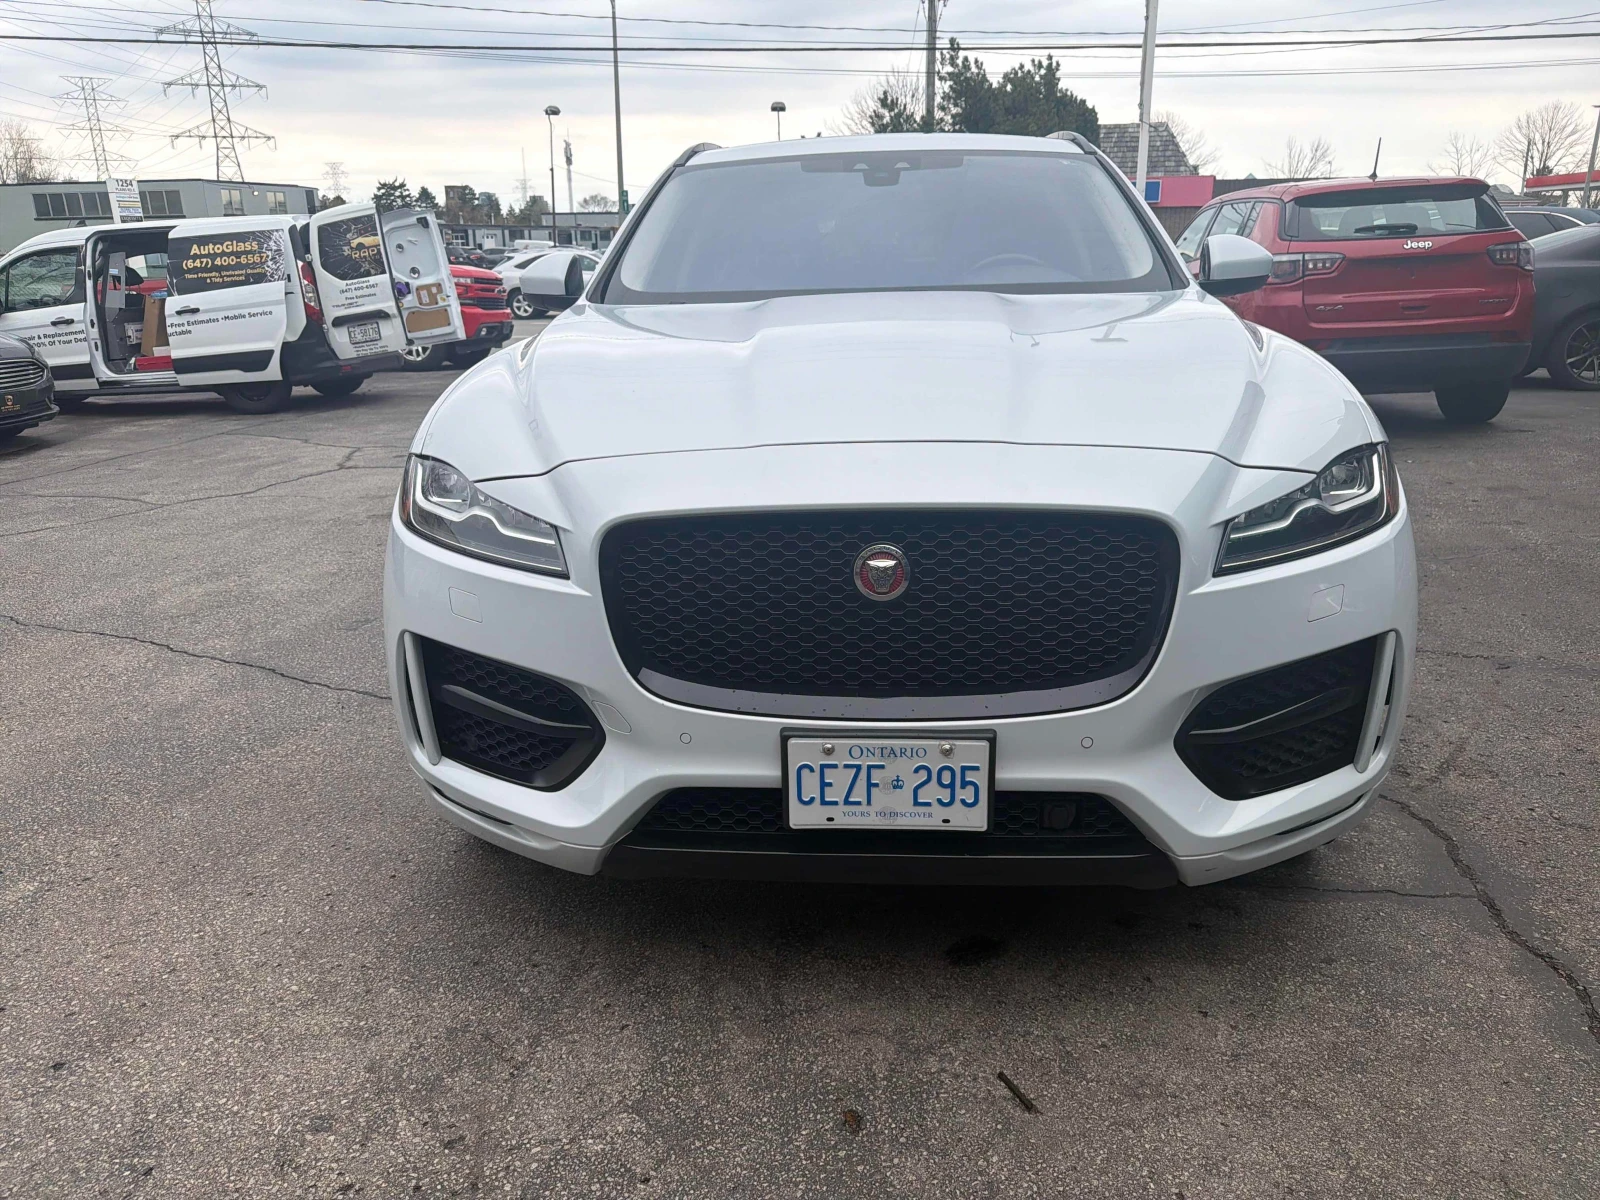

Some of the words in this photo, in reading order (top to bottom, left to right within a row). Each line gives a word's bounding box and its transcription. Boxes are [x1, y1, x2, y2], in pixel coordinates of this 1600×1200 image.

[116, 179, 133, 188] 1254
[190, 240, 258, 256] AutoGlass
[1403, 240, 1432, 250] Jeep
[352, 246, 380, 260] RAP
[182, 258, 212, 270] (647)
[214, 253, 267, 266] 400-6567
[187, 317, 219, 327] Estimates
[248, 310, 273, 318] Service
[43, 329, 85, 339] Replacement
[849, 745, 927, 760] ONTARIO
[796, 762, 885, 806] CEZF
[913, 763, 980, 808] 295
